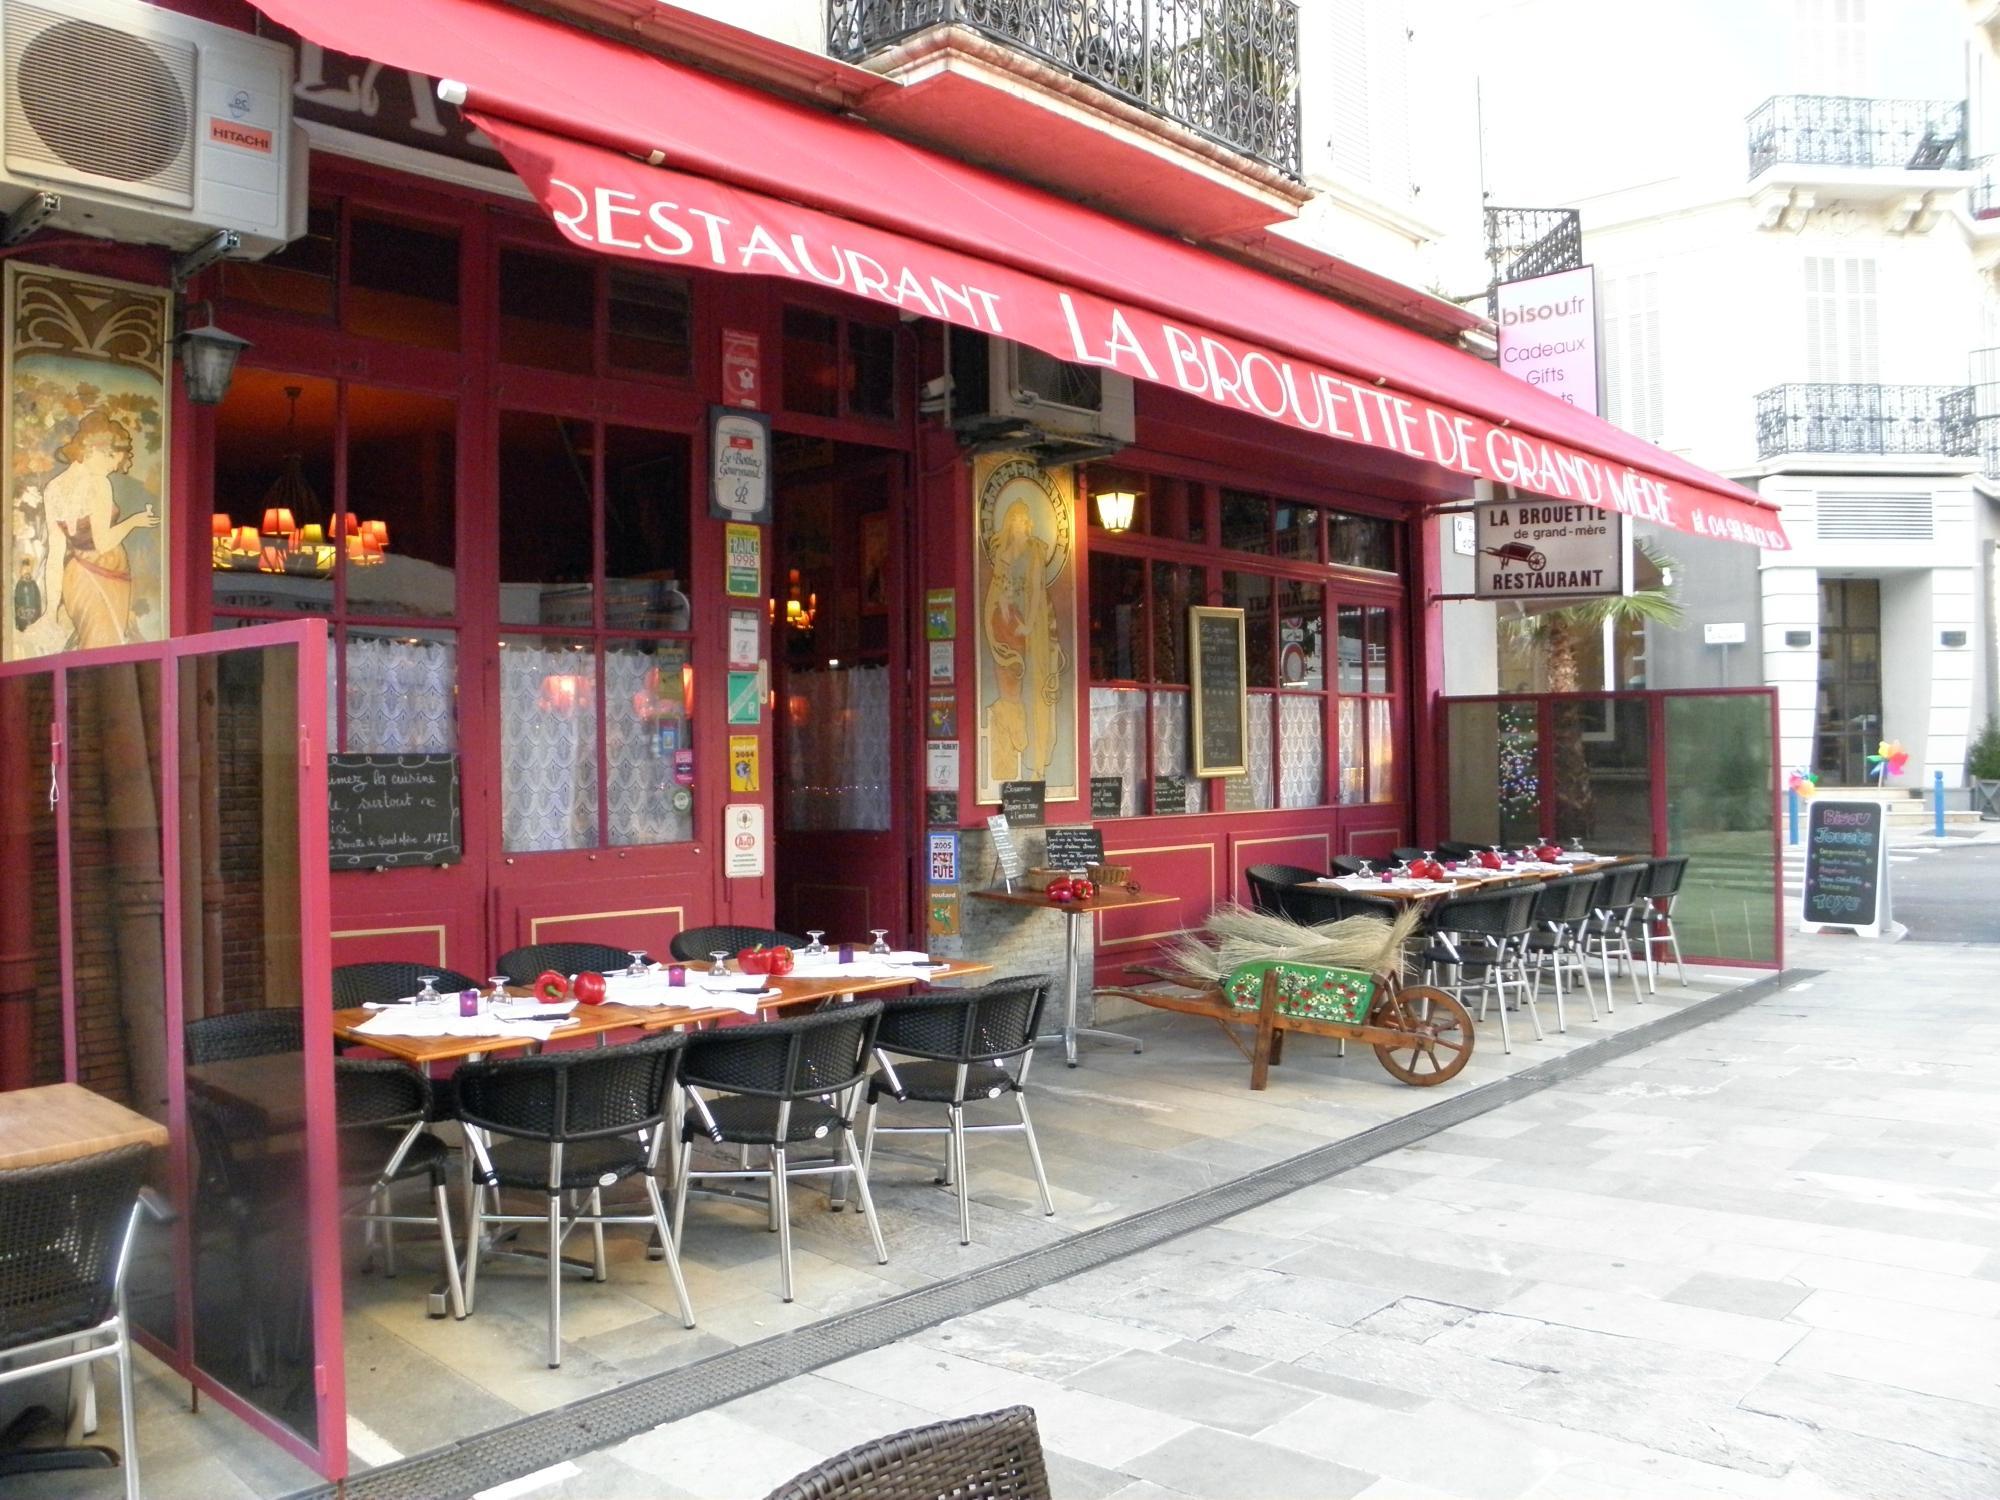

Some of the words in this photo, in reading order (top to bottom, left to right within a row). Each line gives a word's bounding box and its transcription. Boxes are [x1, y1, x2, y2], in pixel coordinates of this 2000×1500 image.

[213, 127, 268, 149] HITACHI
[1502, 296, 1584, 326] bisou.fr
[549, 179, 1004, 332] RESTAURANT
[1059, 293, 1159, 380] LA
[1162, 324, 1425, 457] BROUETTE
[1426, 408, 1482, 474] DE
[1605, 466, 1677, 527] MÈRE
[1504, 339, 1585, 362] Cadeaux
[1526, 368, 1564, 385] Gifts
[1490, 510, 1509, 526] LA
[1520, 504, 1606, 525] BROUETTE
[1514, 529, 1528, 539] de
[729, 536, 759, 555] FRANCE
[733, 554, 755, 567] 1998
[1493, 569, 1603, 590] RESTAURANT
